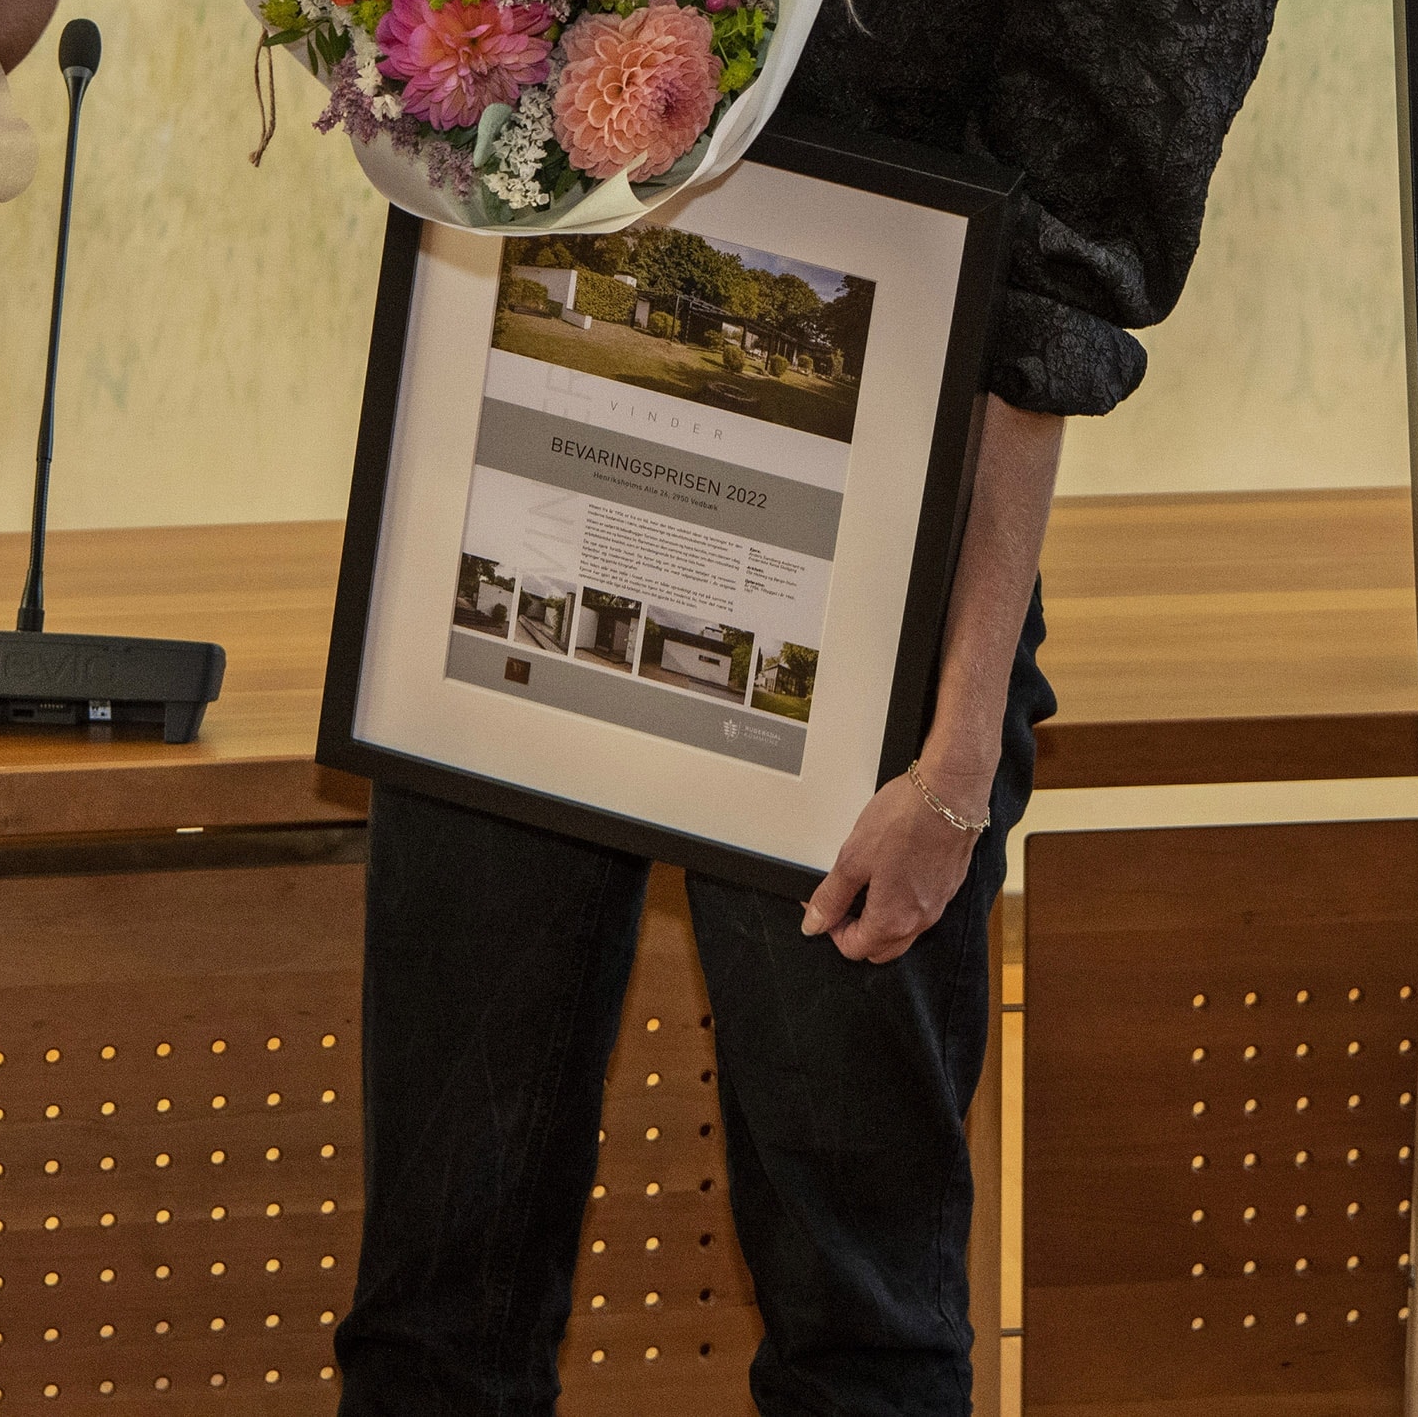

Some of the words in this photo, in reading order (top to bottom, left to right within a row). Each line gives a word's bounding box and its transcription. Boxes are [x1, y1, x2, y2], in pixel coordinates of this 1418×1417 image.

[610, 400, 723, 440] VINDER
[550, 436, 722, 497] BEVARINGSPRISEN
[727, 485, 768, 509] 2022
